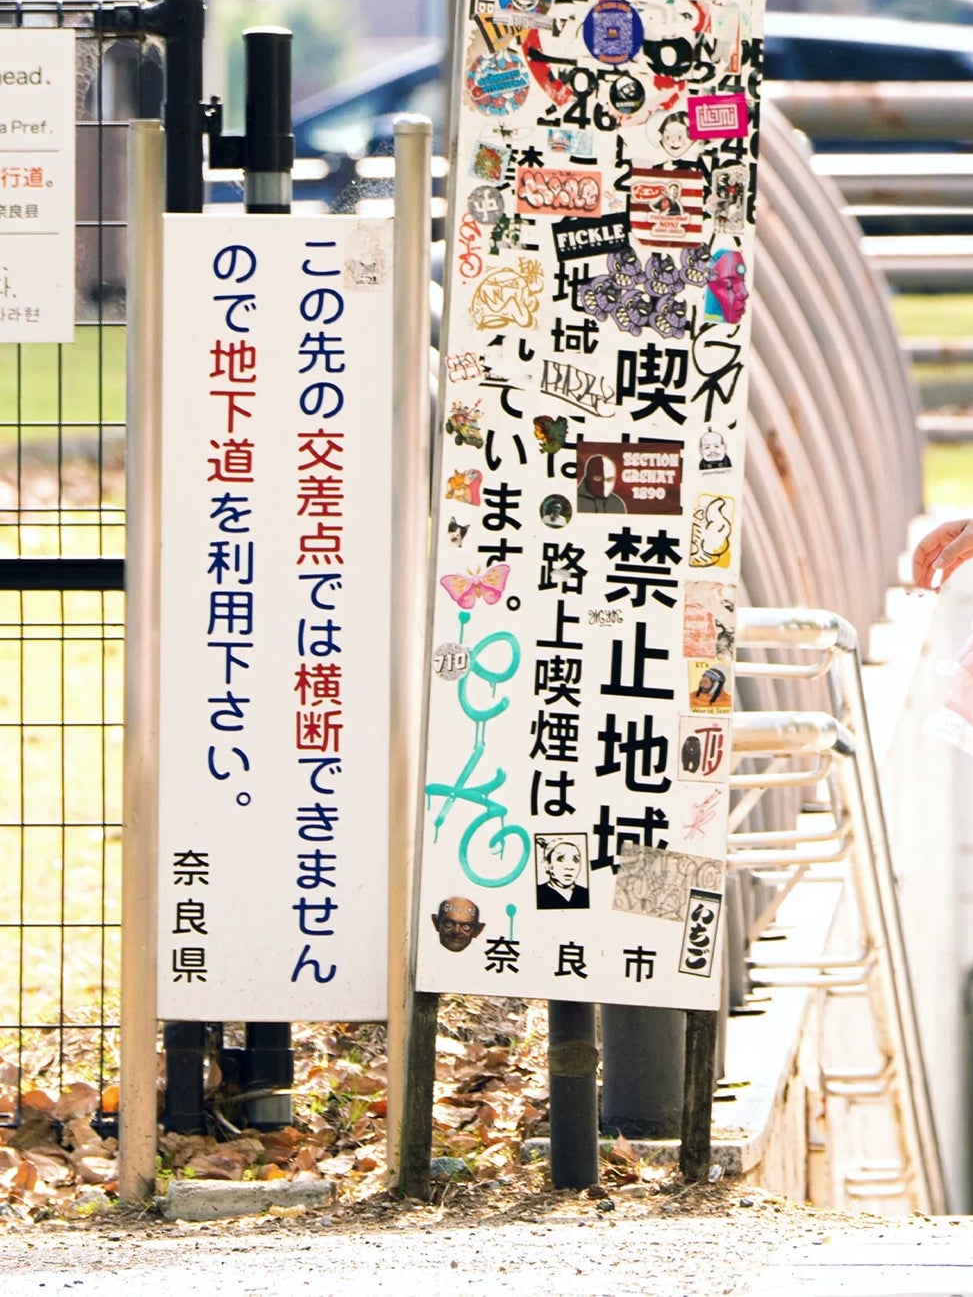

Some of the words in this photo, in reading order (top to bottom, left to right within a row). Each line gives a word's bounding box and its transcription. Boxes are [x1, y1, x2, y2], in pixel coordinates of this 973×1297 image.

[0, 66, 51, 86] ead.
[11, 119, 54, 134] Pref.
[556, 223, 626, 248] FICKLE
[206, 243, 258, 807] ので地下道を利用下さい。
[291, 240, 346, 985] この先の交差点では横断できません
[171, 849, 210, 984] 奈良県
[684, 902, 715, 970] いちご
[483, 935, 658, 984] 奈良市
